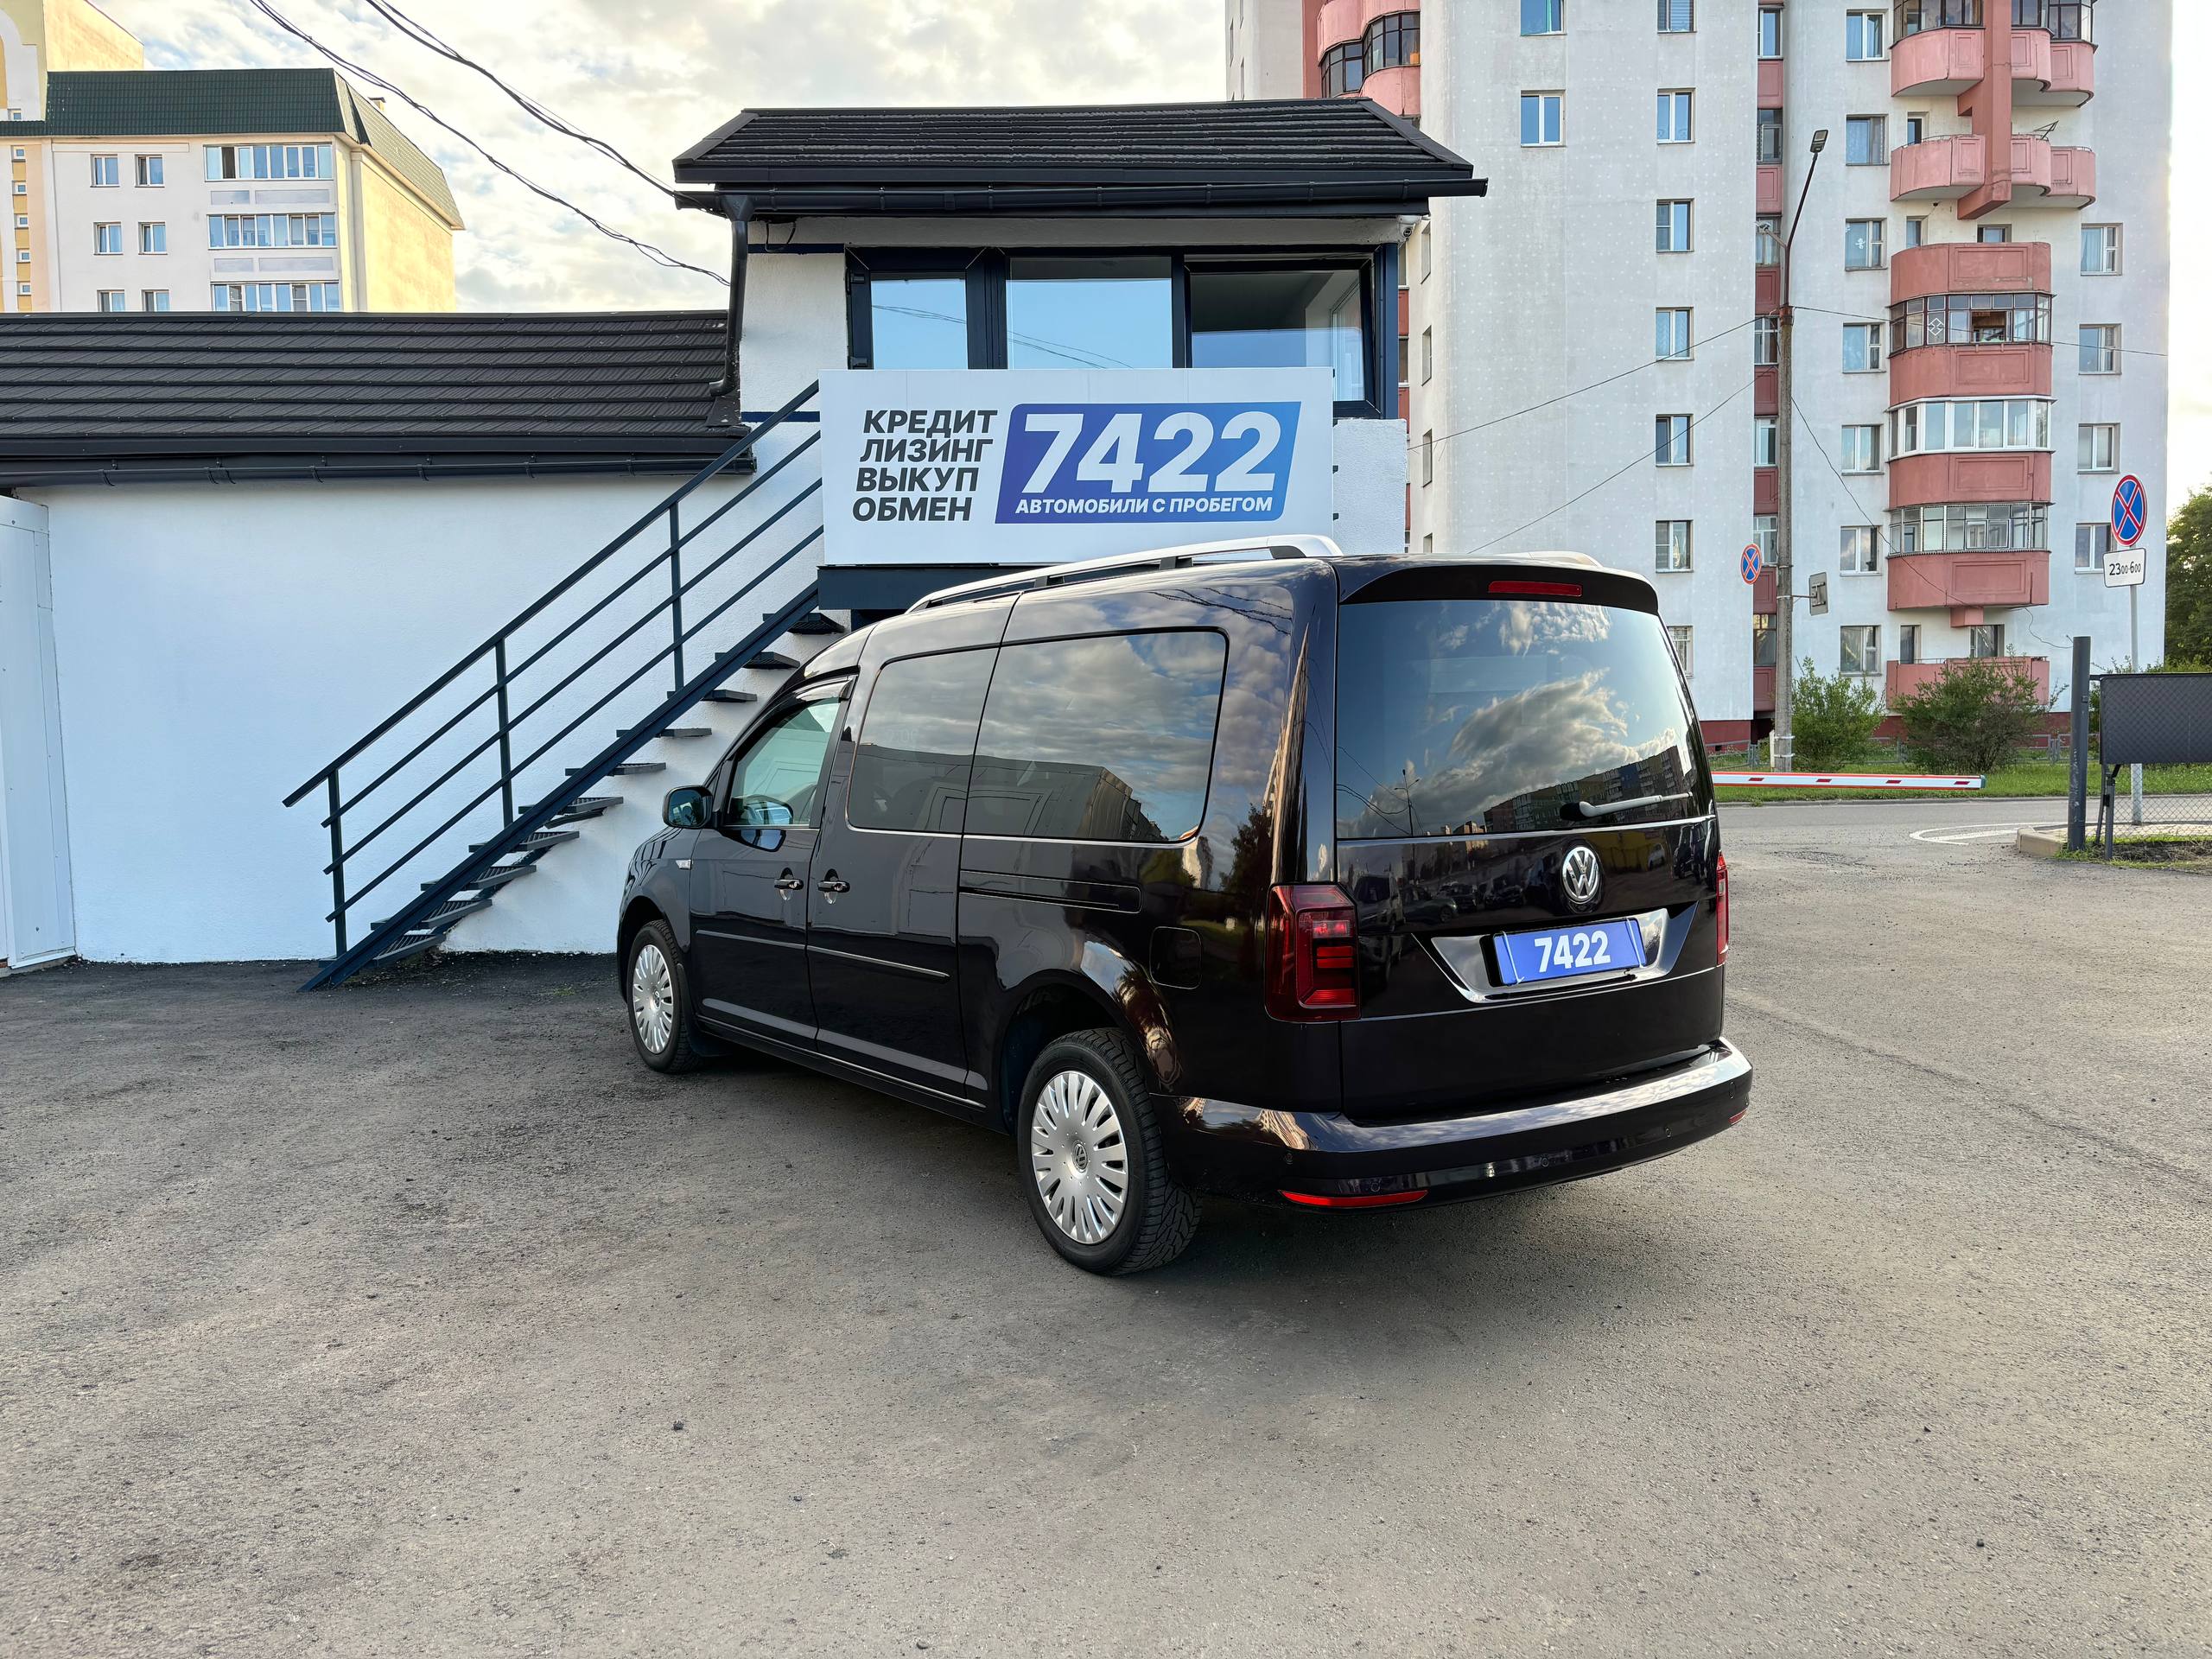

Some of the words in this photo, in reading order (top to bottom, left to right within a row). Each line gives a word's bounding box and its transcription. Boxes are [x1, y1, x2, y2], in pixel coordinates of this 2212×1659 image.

[863, 410, 998, 438] КРЕДИТ
[860, 439, 994, 462] ЛИЗИНГ
[1021, 411, 1281, 493] 7422
[856, 467, 979, 492] ВЫКУП
[852, 497, 972, 522] ОБМЕН
[1015, 499, 1149, 514] АВТОМОБИЛИ
[1152, 498, 1166, 513] С
[1169, 497, 1272, 512] ПРОБЕГОМ
[1535, 931, 1611, 973] 7422
